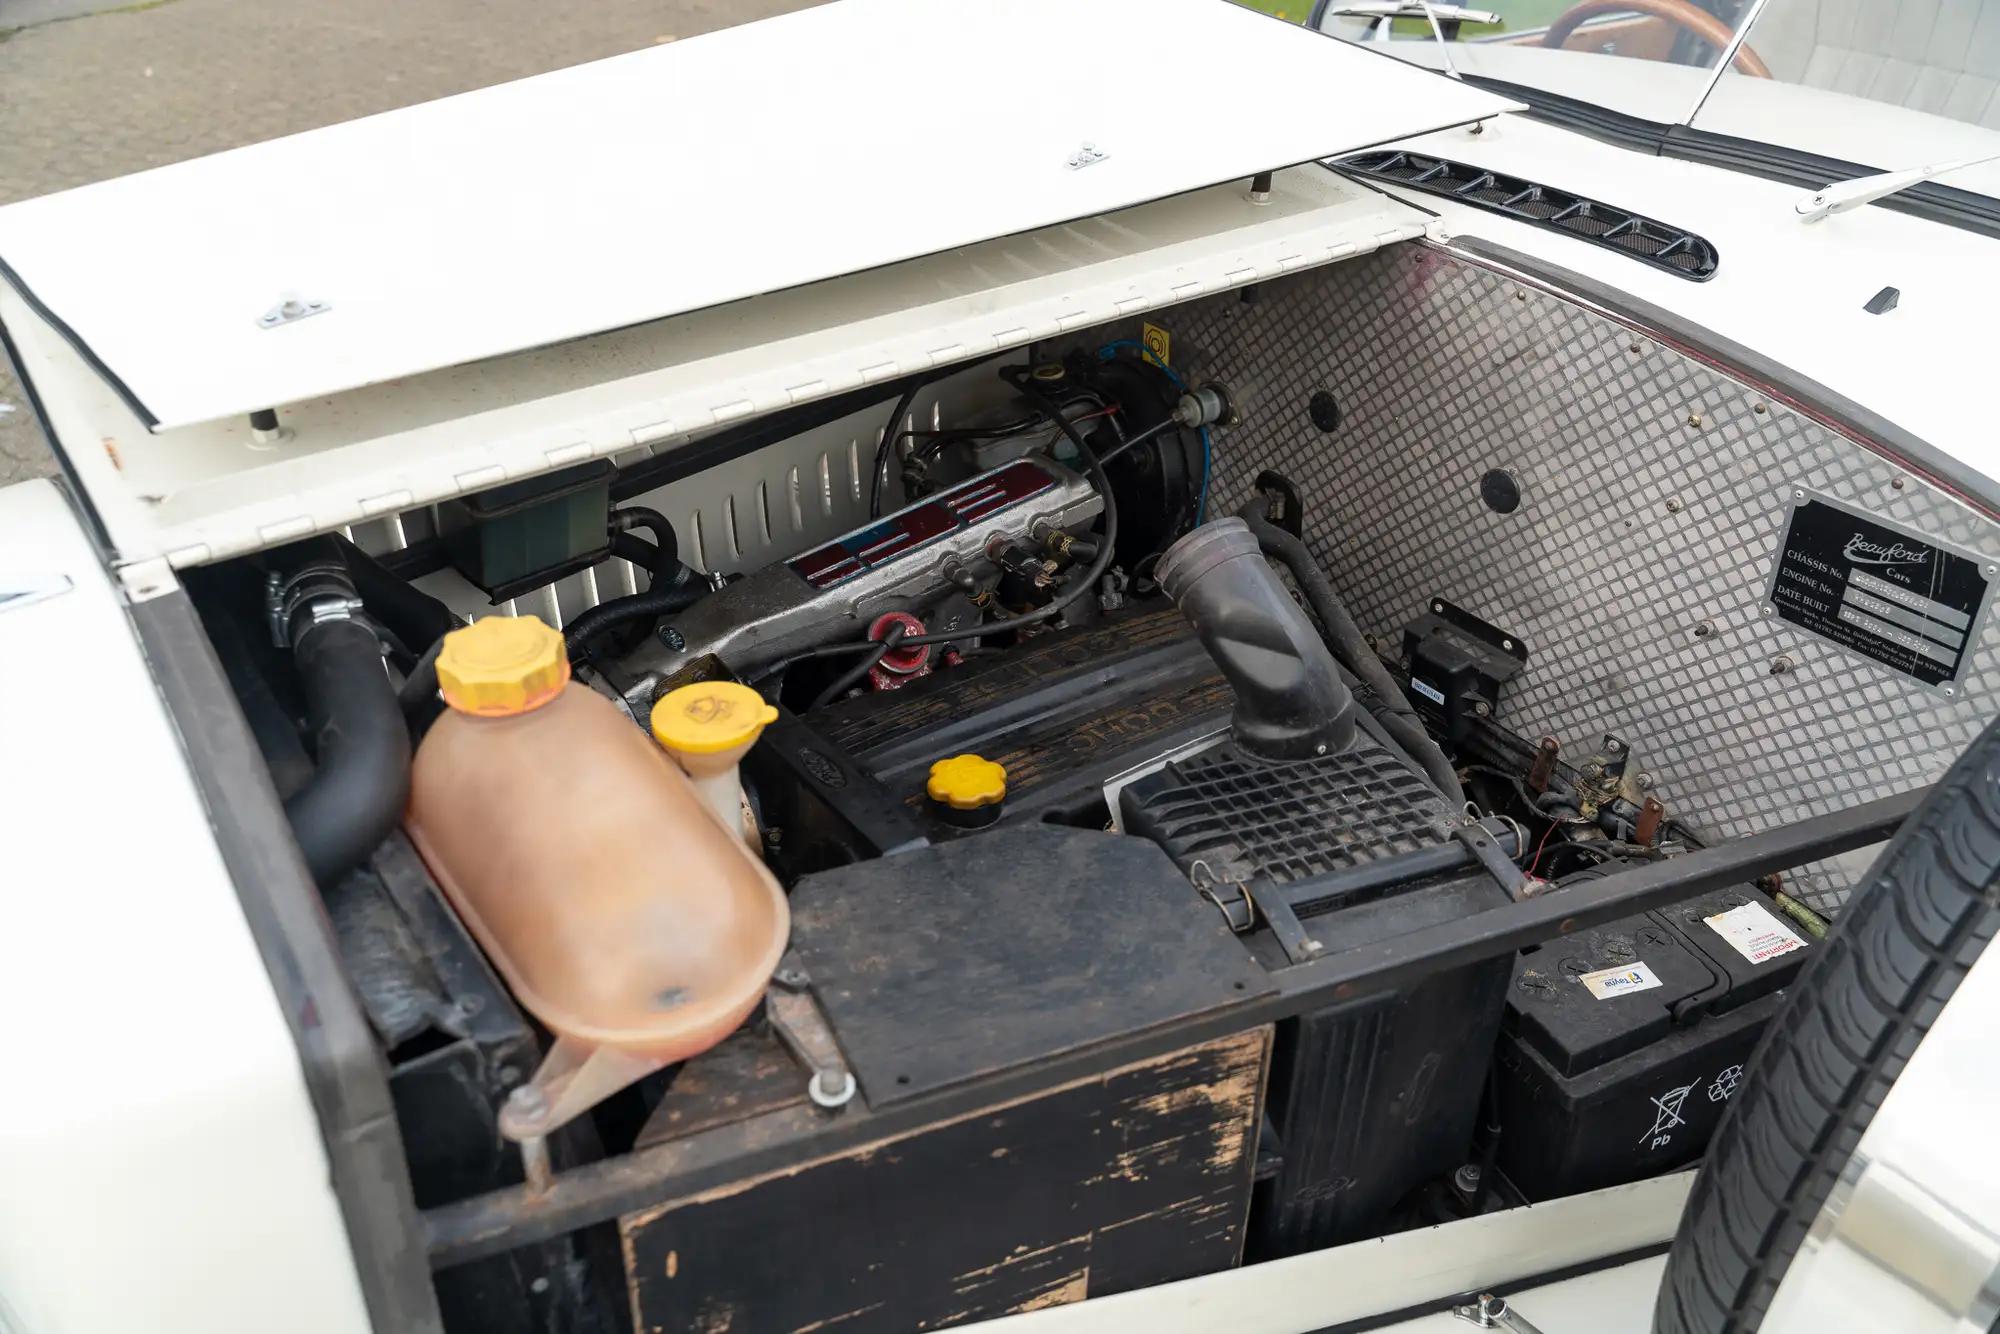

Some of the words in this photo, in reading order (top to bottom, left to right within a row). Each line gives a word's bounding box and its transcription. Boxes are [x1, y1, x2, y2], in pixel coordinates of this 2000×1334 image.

[1844, 533, 1930, 564] Beauford
[1787, 549, 1828, 573] CHASSIS
[1830, 568, 1844, 580] No.
[1886, 566, 1910, 584] Cars
[1782, 567, 1818, 590] ENGINE
[1818, 583, 1834, 595] No.
[1777, 585, 1802, 602] DATE
[1802, 594, 1830, 613] BUILT
[1604, 976, 1632, 988] Tayna
[1651, 1134, 1671, 1150] Pb
